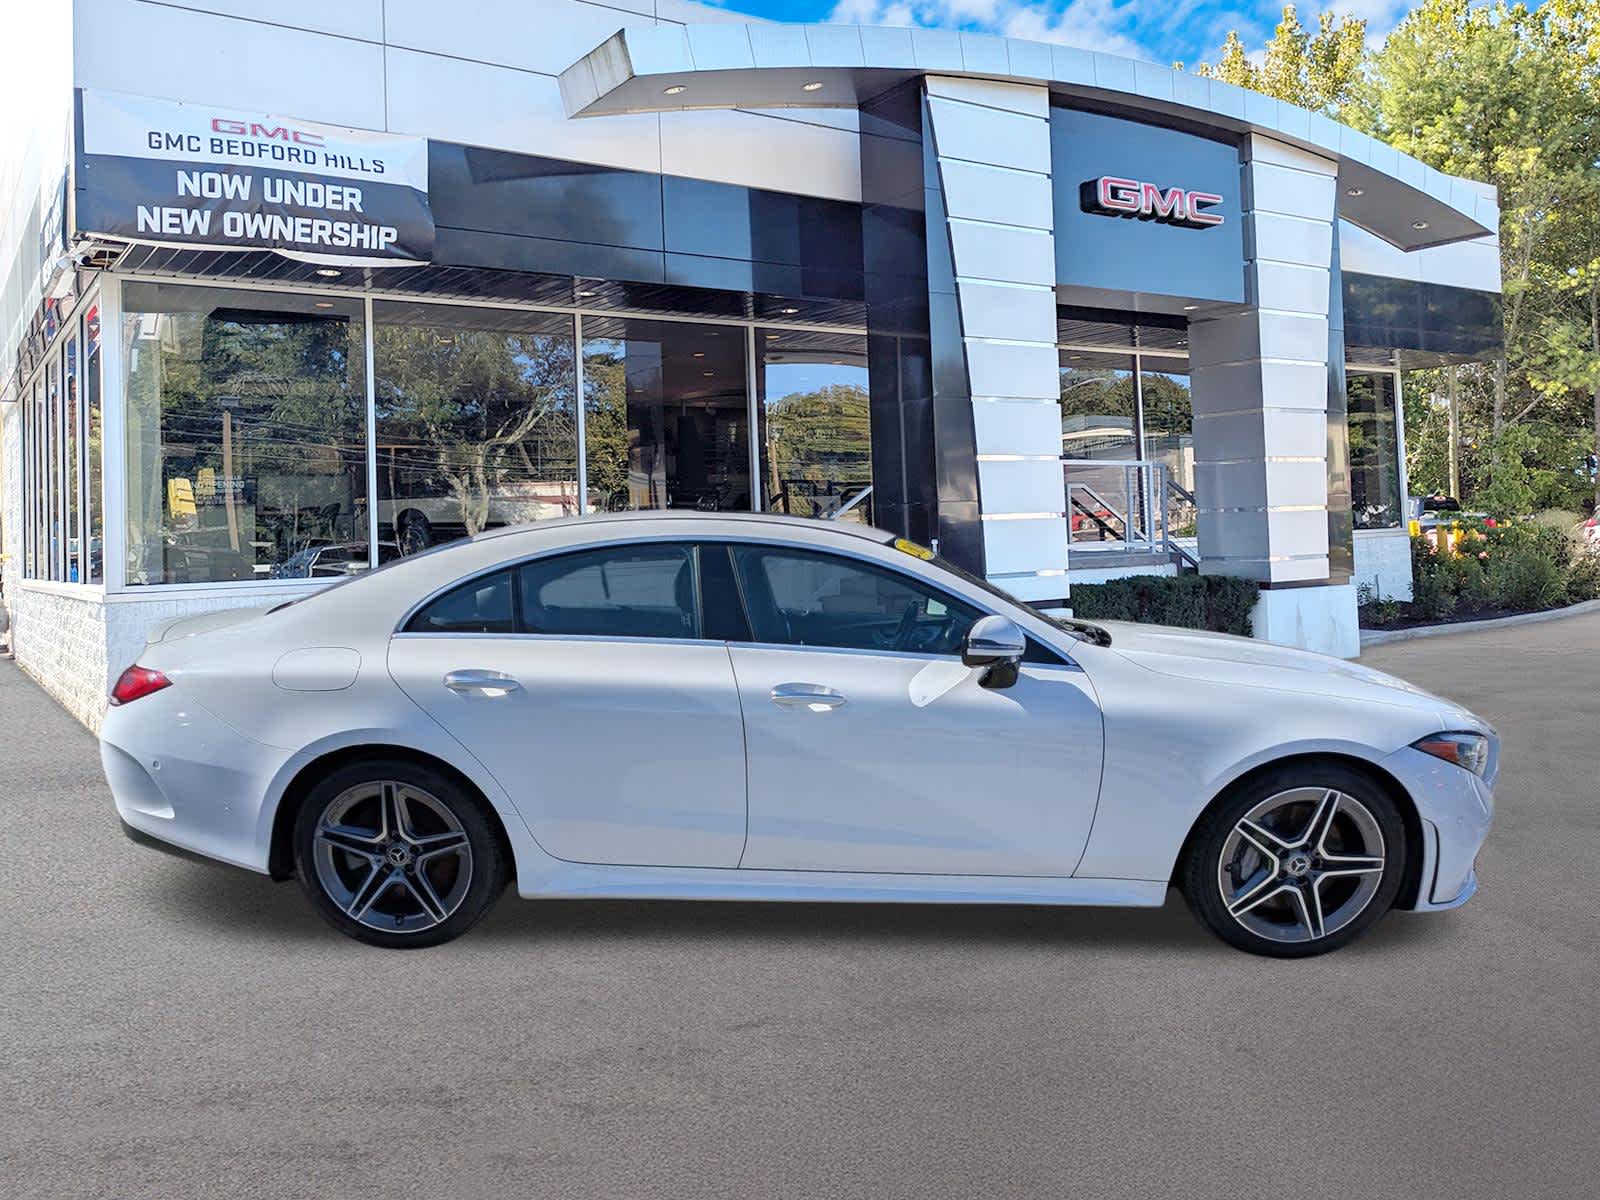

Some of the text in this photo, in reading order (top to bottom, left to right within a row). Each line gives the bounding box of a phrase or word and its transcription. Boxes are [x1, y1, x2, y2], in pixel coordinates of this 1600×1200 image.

[147, 131, 385, 174] GMC BEDFORD HILLS
[211, 118, 326, 148] GMC
[176, 170, 364, 213] NOW UNDER
[1097, 175, 1225, 225] GMC
[136, 205, 398, 250] NEW OWNERSHIP
